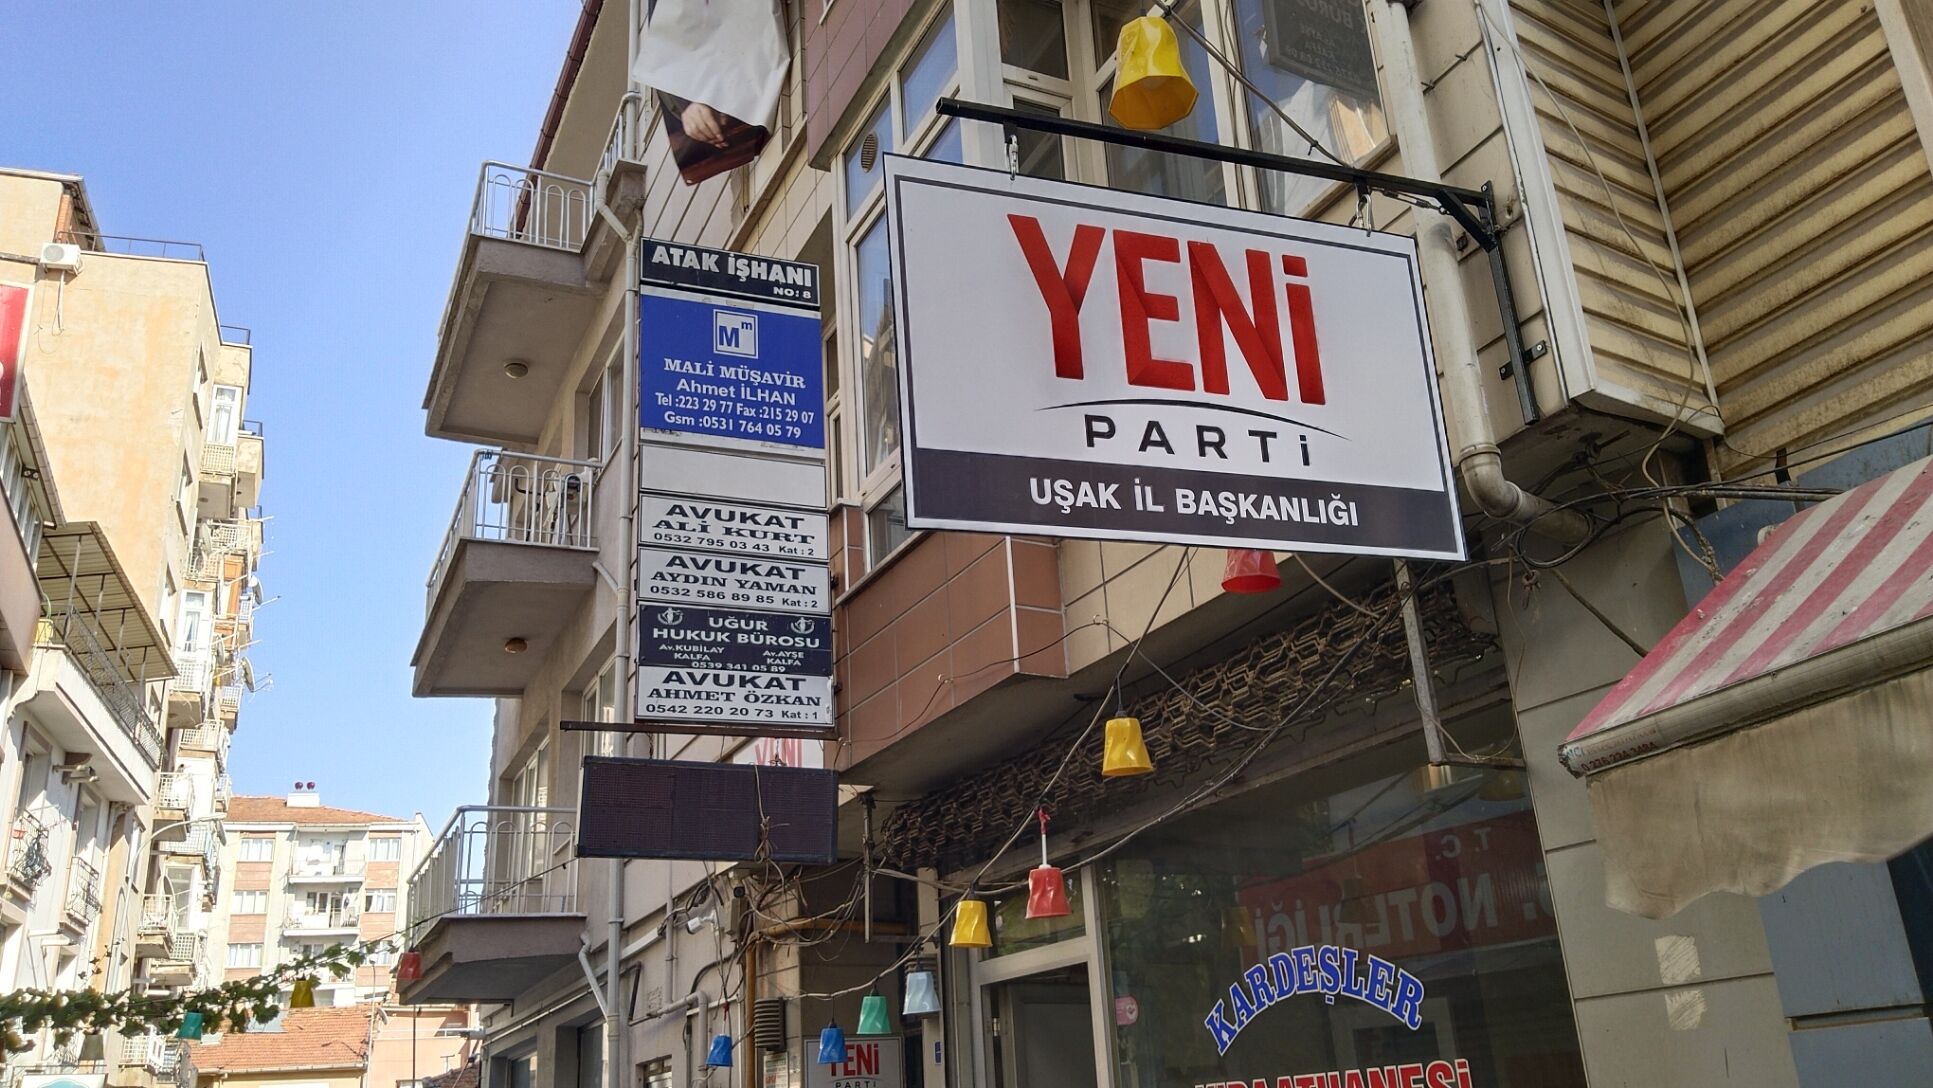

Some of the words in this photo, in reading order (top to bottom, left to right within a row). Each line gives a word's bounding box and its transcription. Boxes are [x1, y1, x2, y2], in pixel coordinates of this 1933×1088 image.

[652, 245, 720, 273] ATAK
[727, 253, 812, 287] İŞHANI
[803, 290, 812, 299] 8
[664, 358, 714, 377] MALİ
[719, 364, 806, 389] MÜŞAVİR
[676, 378, 735, 399] Ahmet
[740, 385, 796, 406] İLHAN
[703, 399, 716, 412] 29
[719, 402, 733, 415] 77
[785, 409, 799, 422] 29
[801, 411, 815, 425] 07
[739, 419, 762, 435] 764
[766, 423, 782, 437] 05
[786, 426, 801, 439] 79
[1029, 477, 1122, 515] UŞAK
[1133, 477, 1165, 513] İL
[1174, 487, 1360, 527] BAŞKANLIĞI
[666, 504, 805, 530] AVUKAT
[652, 519, 711, 534] ALİ
[722, 526, 815, 545] KURT
[654, 532, 692, 544] 0532
[697, 536, 725, 547] 795
[729, 540, 748, 550] 03
[752, 542, 770, 552] 43
[807, 548, 815, 556] 2
[665, 555, 806, 581] AVUKAT
[650, 571, 727, 587] AYDIN
[734, 578, 817, 596] YAMAN
[650, 585, 690, 597] 0532
[697, 589, 726, 600] 586
[731, 592, 750, 602] 89
[755, 594, 775, 604] 85
[811, 600, 818, 608] 2
[708, 616, 769, 631] UĞUR
[653, 628, 731, 643] HUKUK
[737, 632, 820, 648] BÜROSU
[673, 653, 711, 662] KALFA
[692, 661, 722, 670] 0539
[752, 664, 768, 672] 05
[770, 665, 786, 673] 89
[766, 657, 802, 666] KALFA
[662, 670, 806, 691] AVUKAT
[647, 688, 736, 702] AHMET
[743, 690, 822, 706] ÖZKAN
[645, 703, 688, 714] 0542
[693, 705, 724, 716] 220
[729, 706, 749, 717] 20
[755, 708, 774, 718] 73
[1204, 944, 1425, 1057] KARDEŞLER
